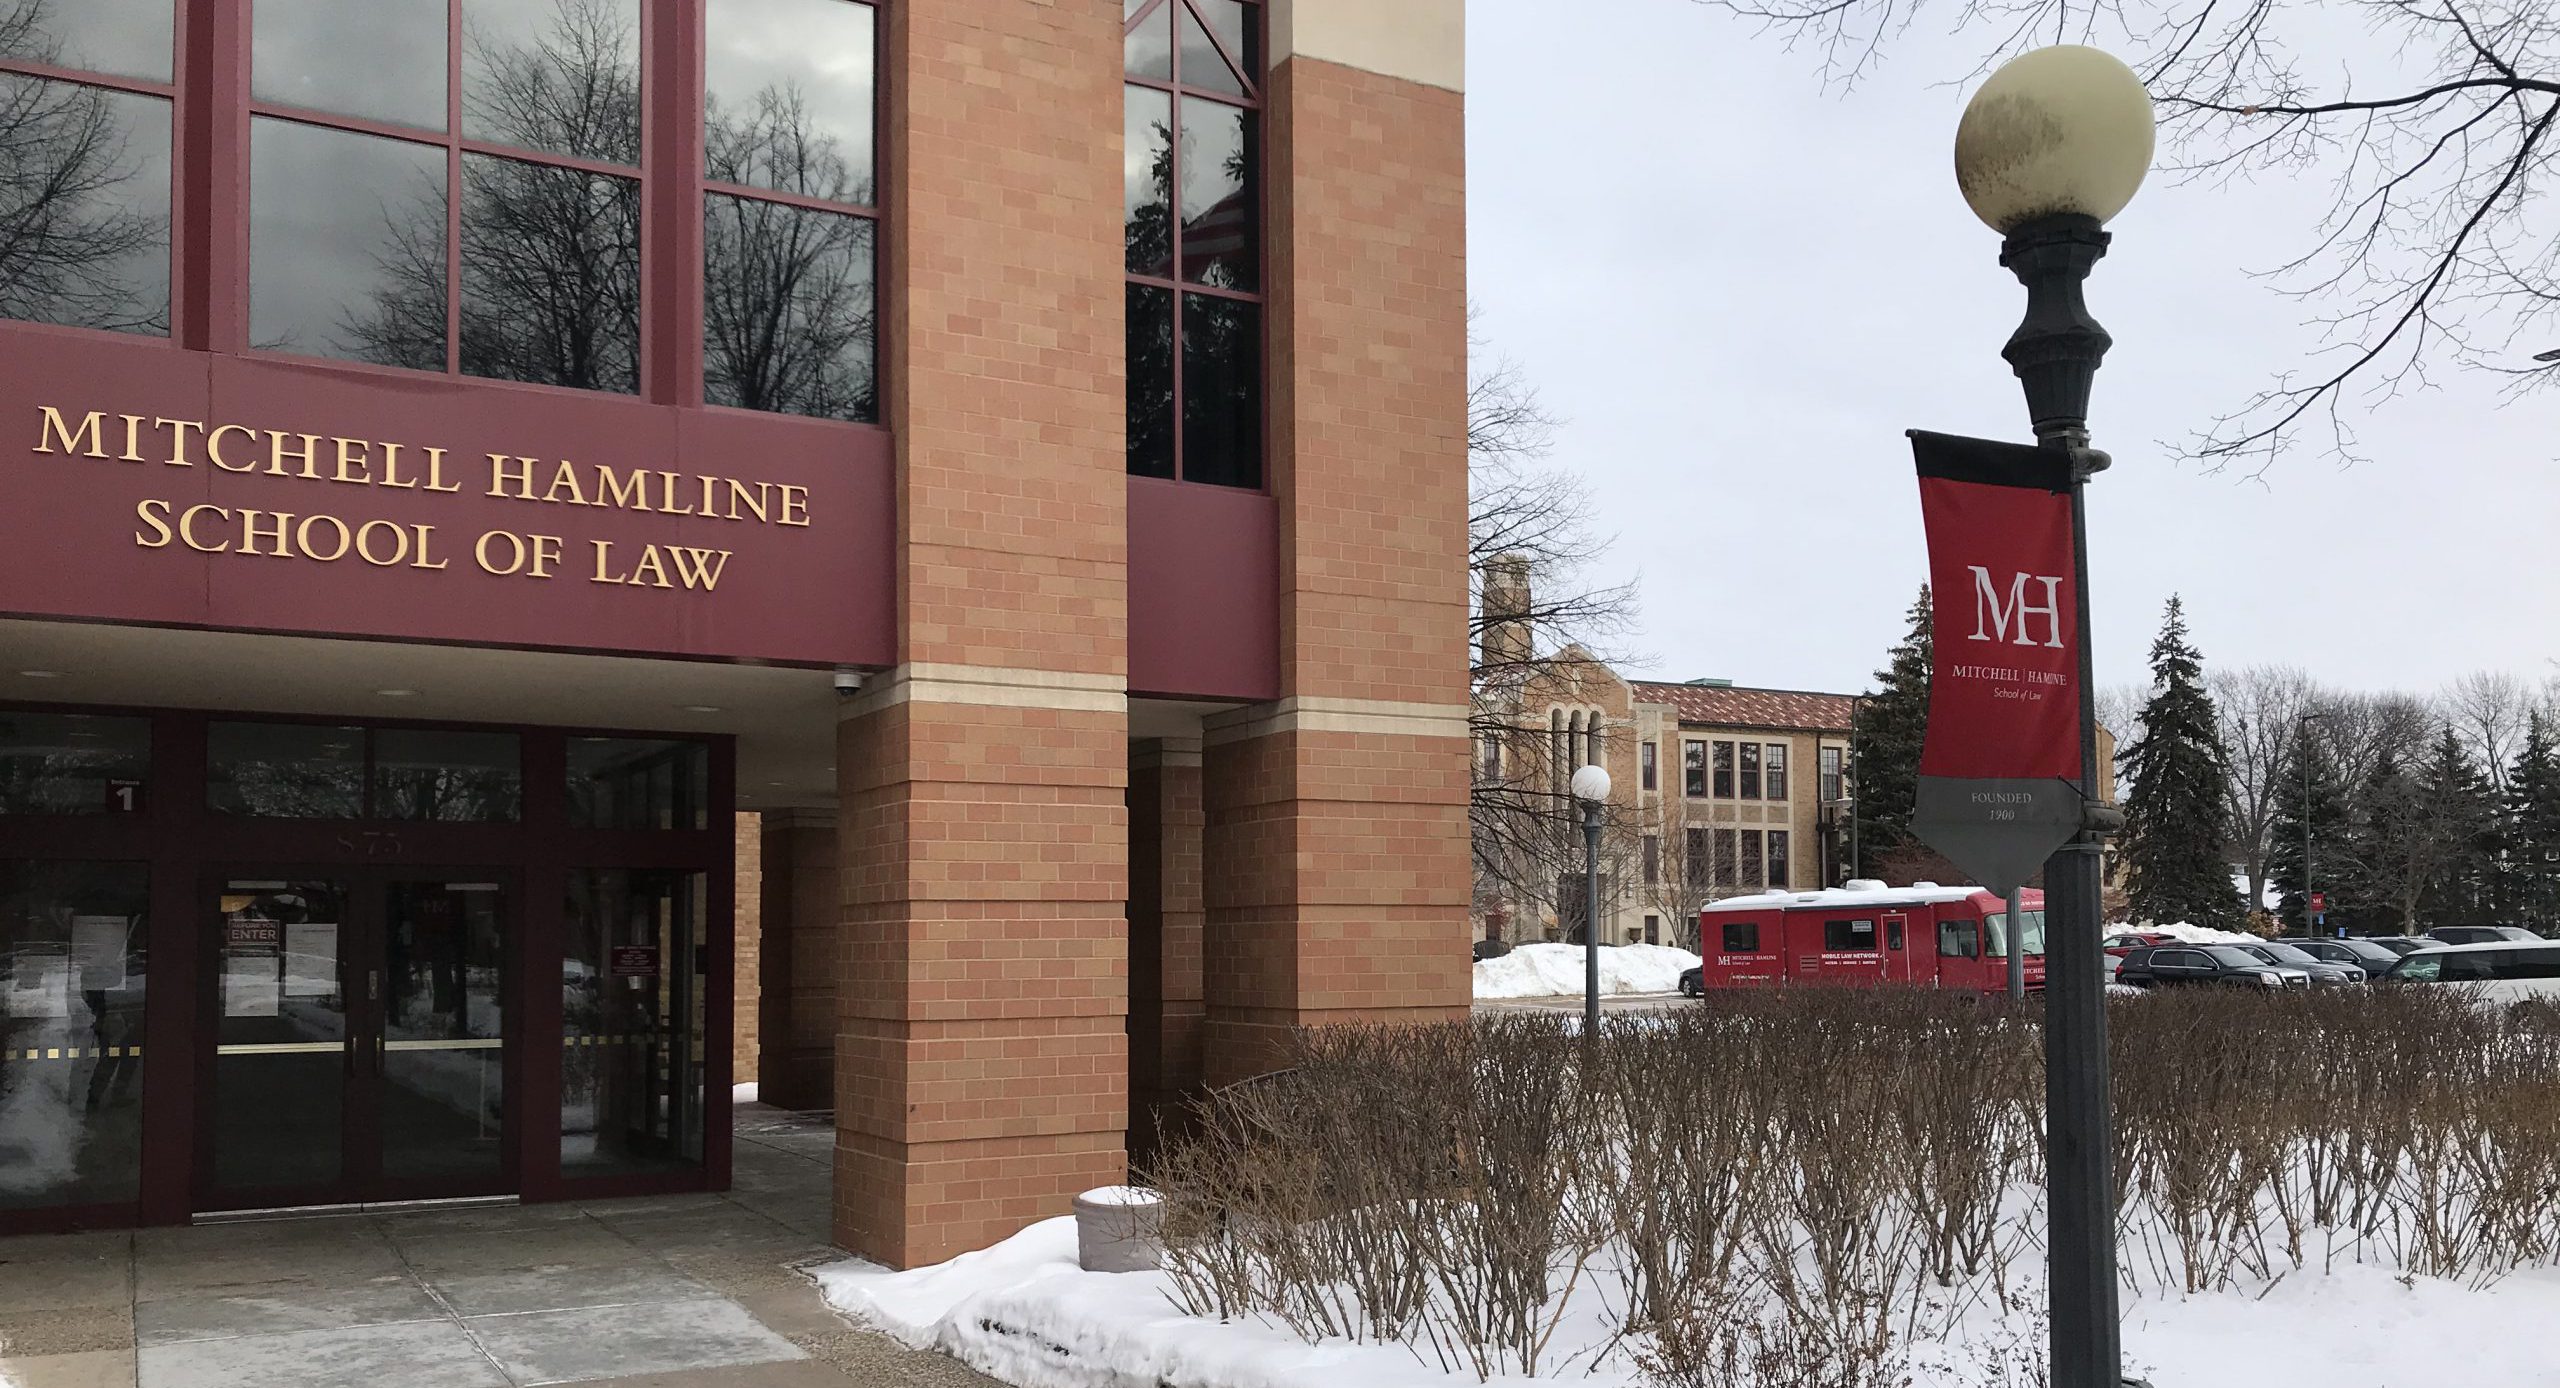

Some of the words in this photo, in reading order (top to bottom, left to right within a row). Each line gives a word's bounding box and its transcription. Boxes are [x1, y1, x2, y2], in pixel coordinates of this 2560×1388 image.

[32, 405, 461, 493] MITCHELL
[485, 453, 811, 527] HAMLINE
[135, 499, 449, 570] SCHOOL
[475, 530, 563, 578] OF
[590, 540, 733, 591] LAW
[1967, 565, 2065, 649] MH
[1952, 665, 2020, 681] MITCHELL
[1994, 687, 2019, 699] School
[2020, 690, 2028, 702] of
[2029, 691, 2041, 700] Law
[116, 787, 132, 811] 1
[1971, 792, 2032, 803] FOUNDED
[1990, 809, 2015, 820] 1900
[232, 930, 276, 940] ENTER
[1717, 955, 1731, 966] MH
